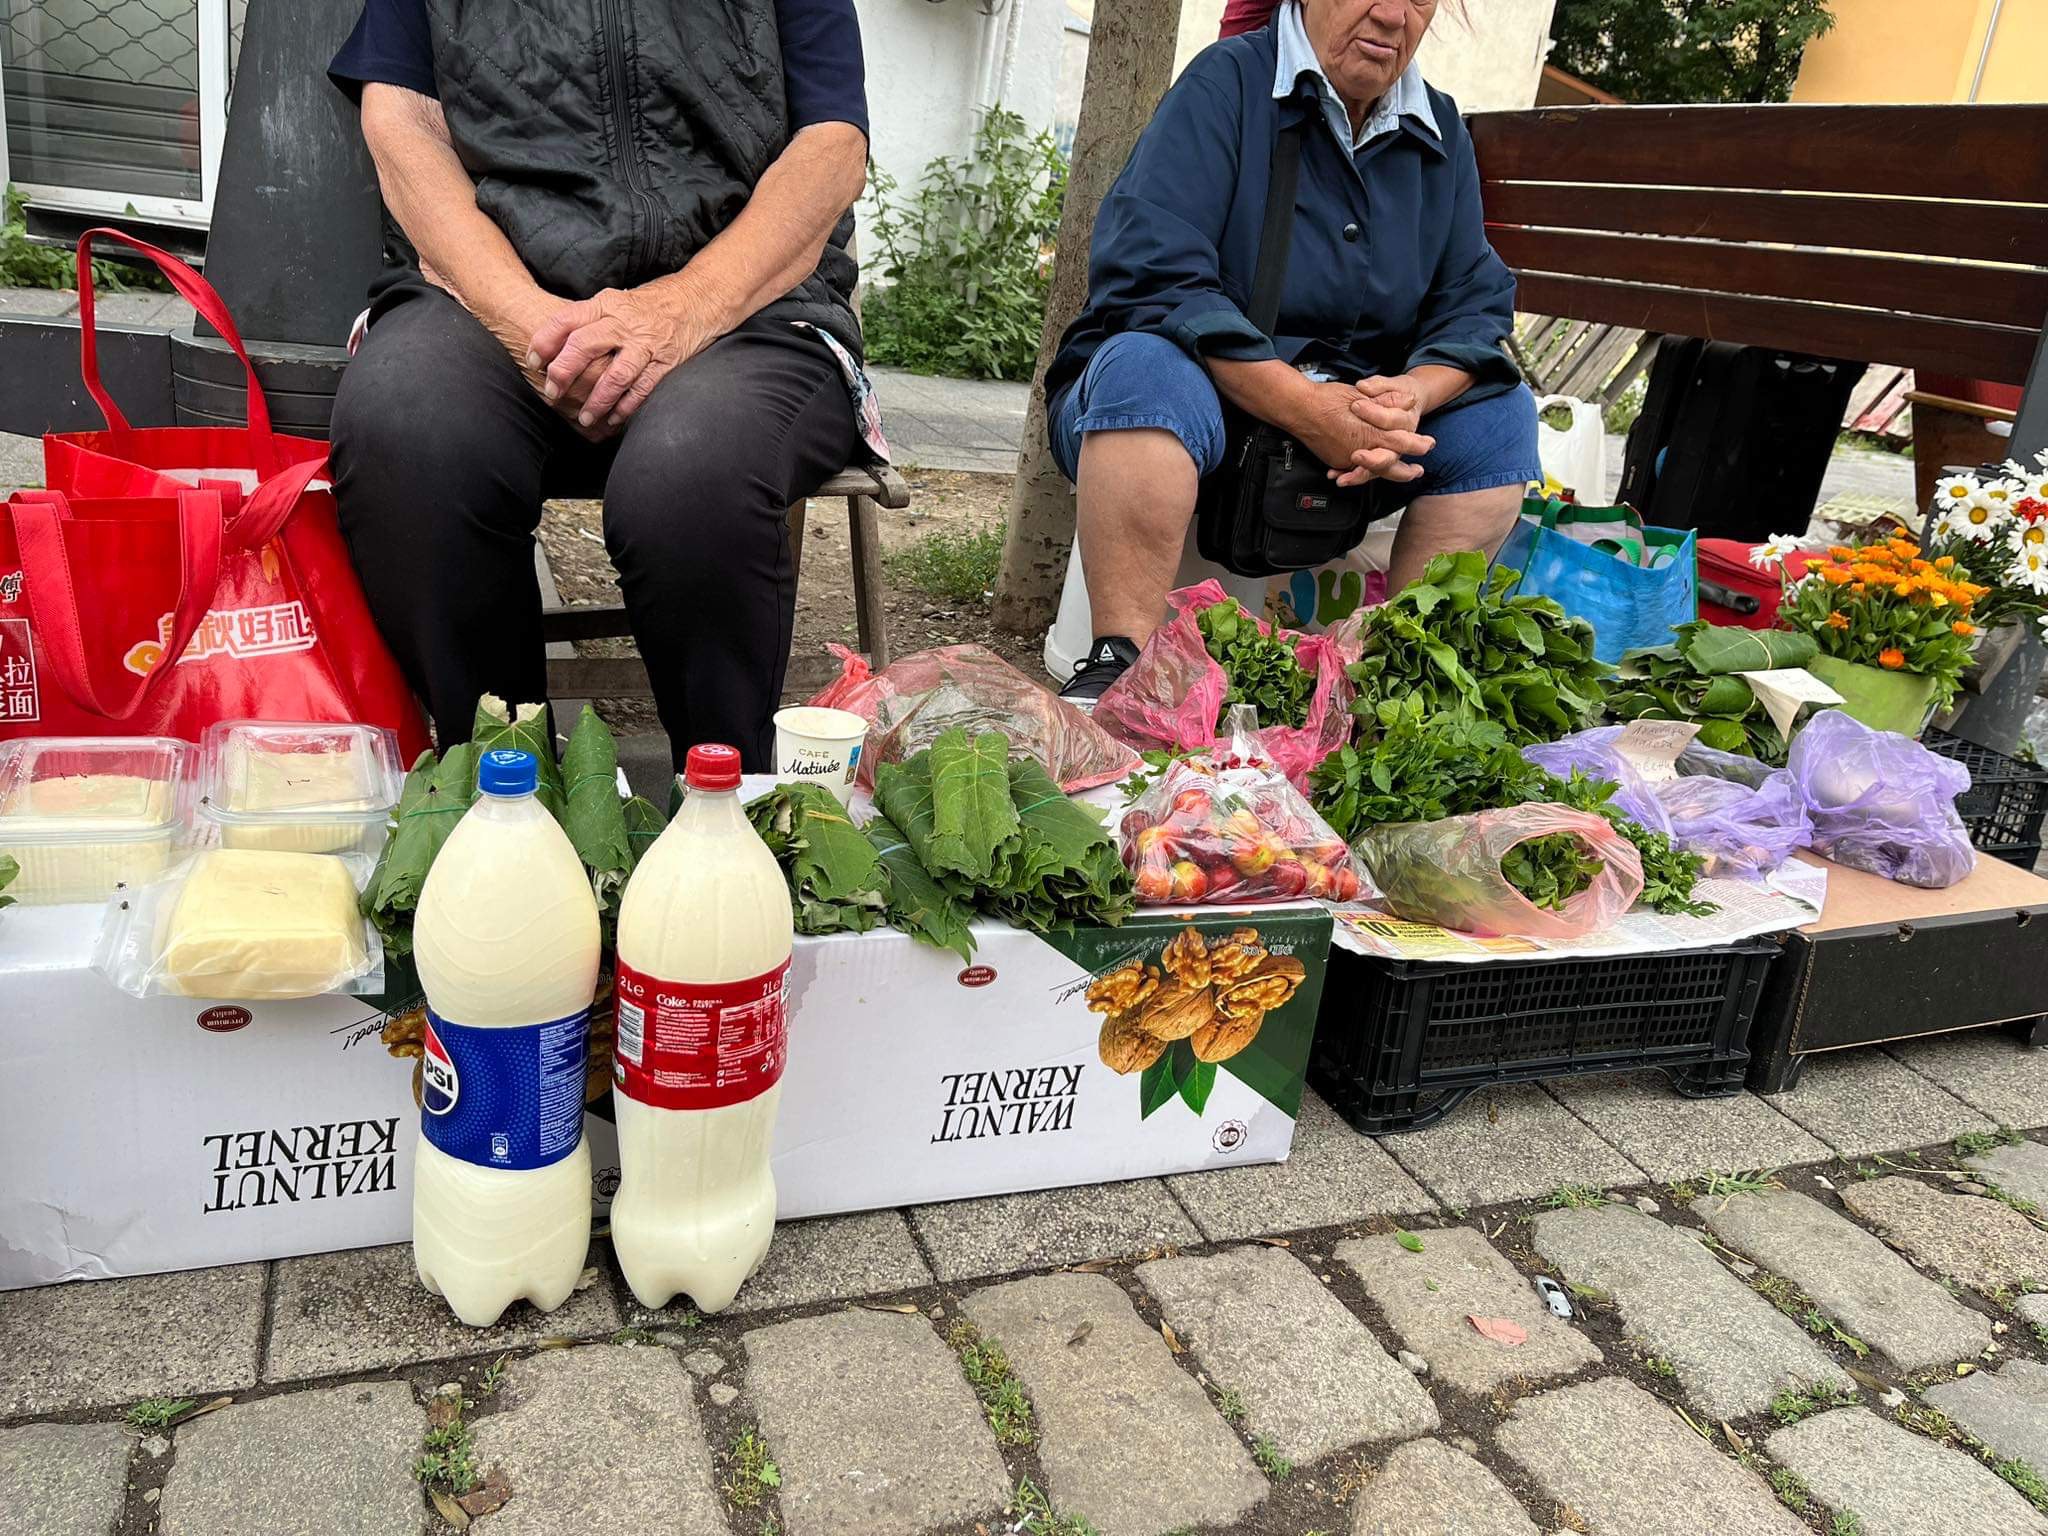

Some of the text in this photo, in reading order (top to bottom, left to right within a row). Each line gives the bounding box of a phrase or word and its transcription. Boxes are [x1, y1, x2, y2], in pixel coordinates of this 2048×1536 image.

[5, 656, 33, 717] 拉面
[783, 759, 841, 775] Matinée
[206, 1017, 244, 1027] premium
[343, 1013, 389, 1050] food!
[424, 1055, 454, 1092] PSI
[941, 1064, 1086, 1106] KERNEL
[930, 1097, 1076, 1145] WALNUT
[203, 1117, 401, 1172] KERNEL
[203, 1154, 397, 1215] WALNUT
